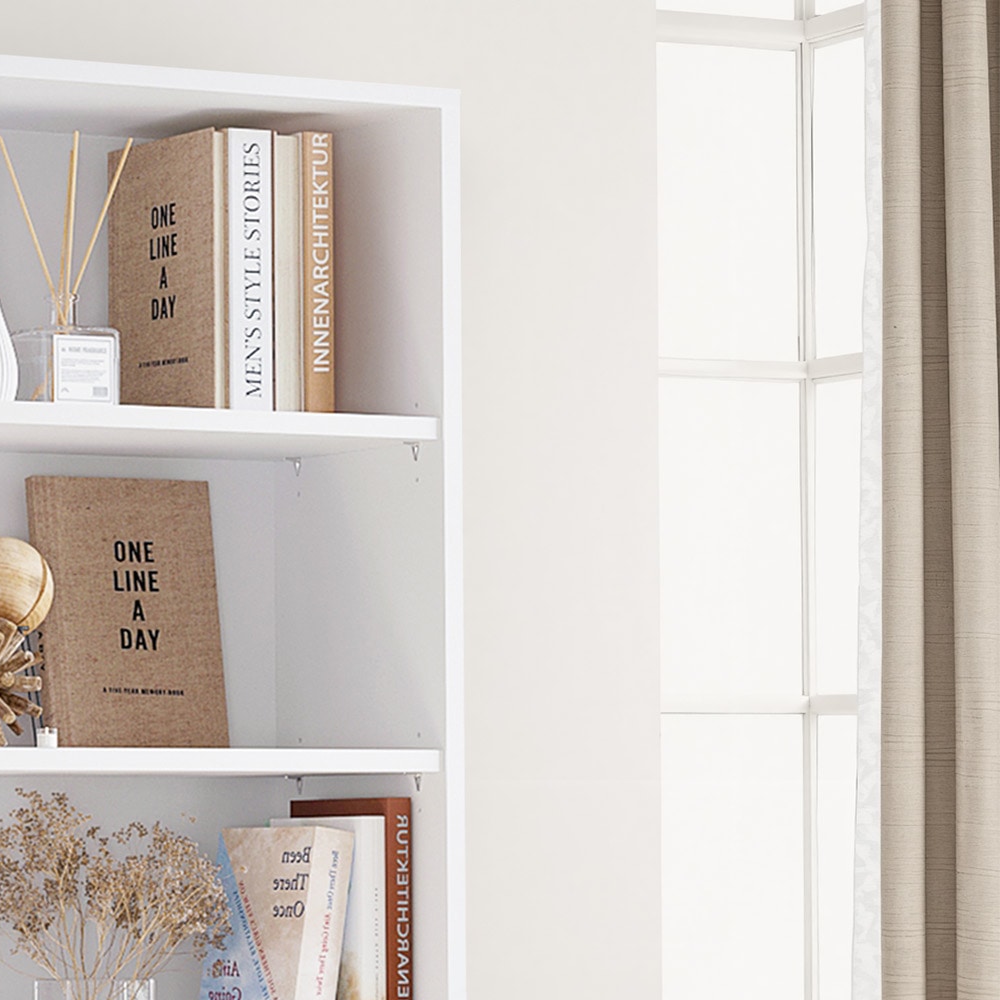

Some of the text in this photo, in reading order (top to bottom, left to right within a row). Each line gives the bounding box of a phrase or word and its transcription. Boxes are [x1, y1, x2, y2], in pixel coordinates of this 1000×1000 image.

[151, 203, 177, 230] ONE
[149, 233, 178, 260] LINE
[312, 133, 330, 373] INNENARCHITEKTUR
[159, 266, 169, 290] A
[243, 142, 262, 397] MEN'S STYLE STORIES
[151, 295, 177, 321] DAY
[113, 540, 155, 563] ONE
[112, 570, 160, 592] LINE
[132, 599, 145, 622] A
[119, 628, 160, 650] DAY
